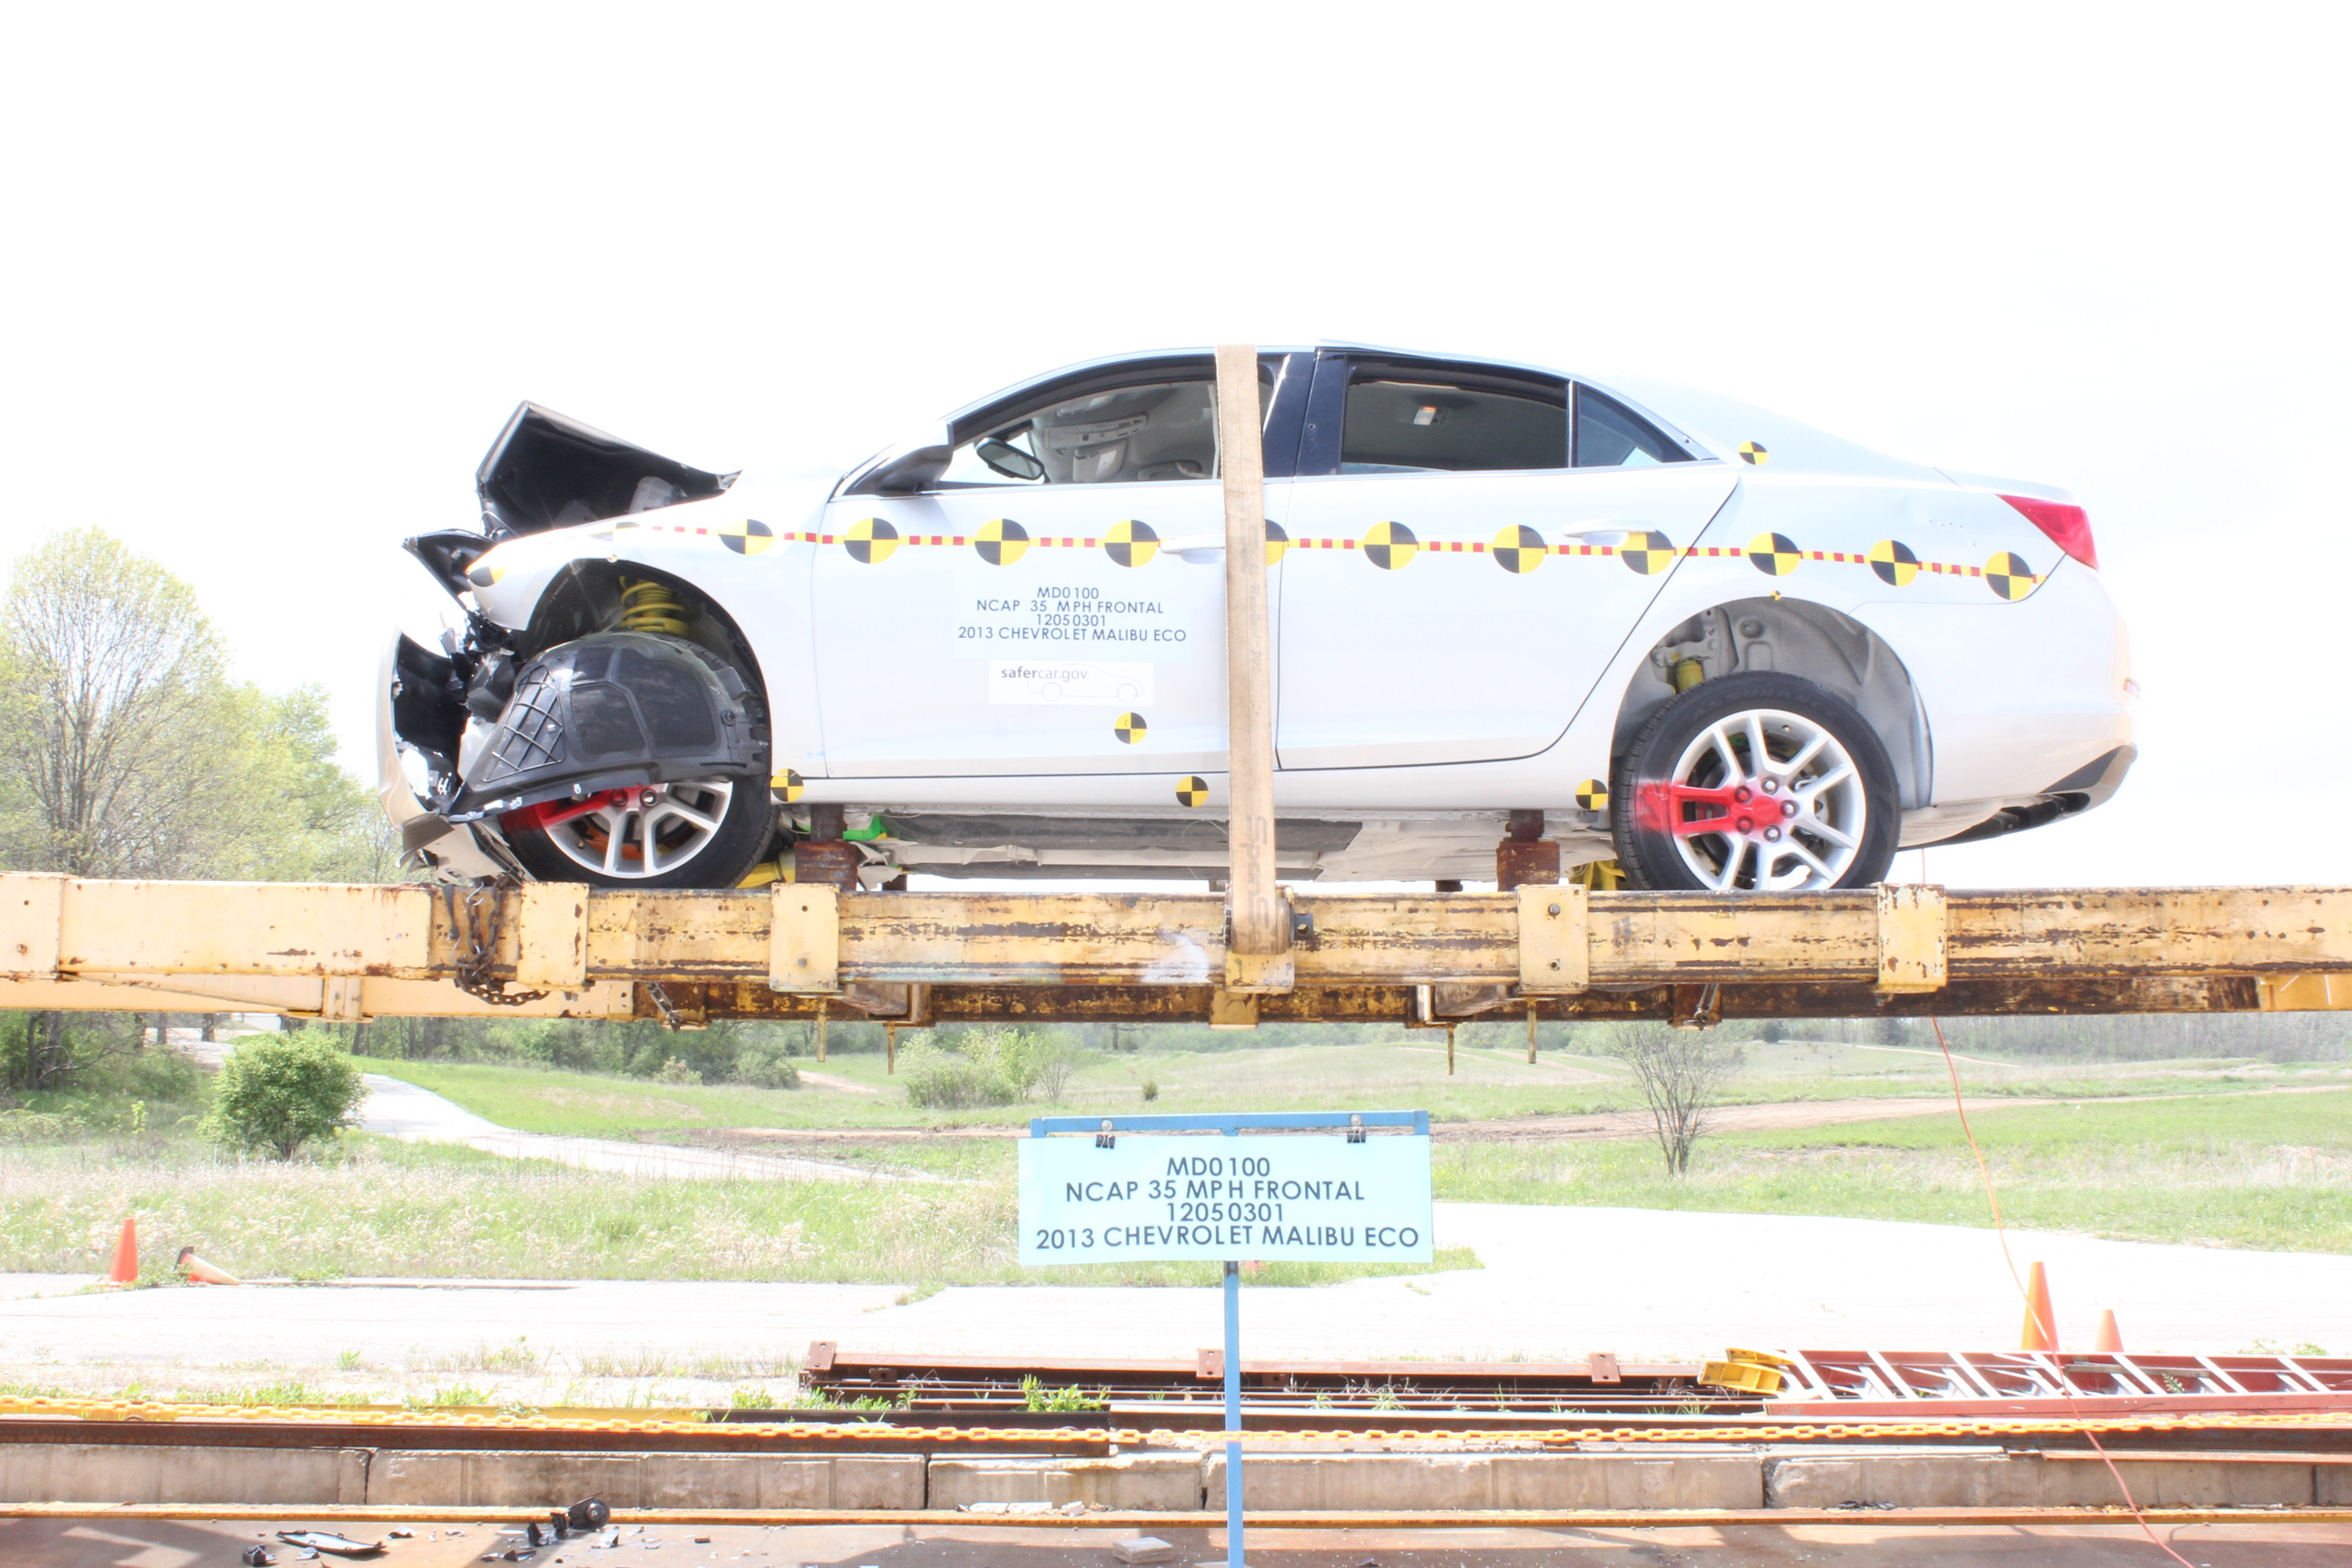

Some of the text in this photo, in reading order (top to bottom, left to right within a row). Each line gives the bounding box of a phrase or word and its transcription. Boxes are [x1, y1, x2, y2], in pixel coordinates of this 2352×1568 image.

[1037, 587, 1099, 599] MD0100
[977, 599, 1163, 613] NCAP 35 MPH FRONTAL
[1037, 613, 1105, 626] 12050301
[958, 626, 1186, 642] 2013 CHEVROLET MALIBU ECO
[1002, 666, 1087, 682] safercar.gov
[1167, 1157, 1270, 1177] MD0100
[1066, 1180, 1365, 1202] NCAP 35 MPH FRONTAL
[1167, 1202, 1282, 1222] 12050301
[1036, 1225, 1418, 1250] 2013 CHEVROLET MALIBU ECO
